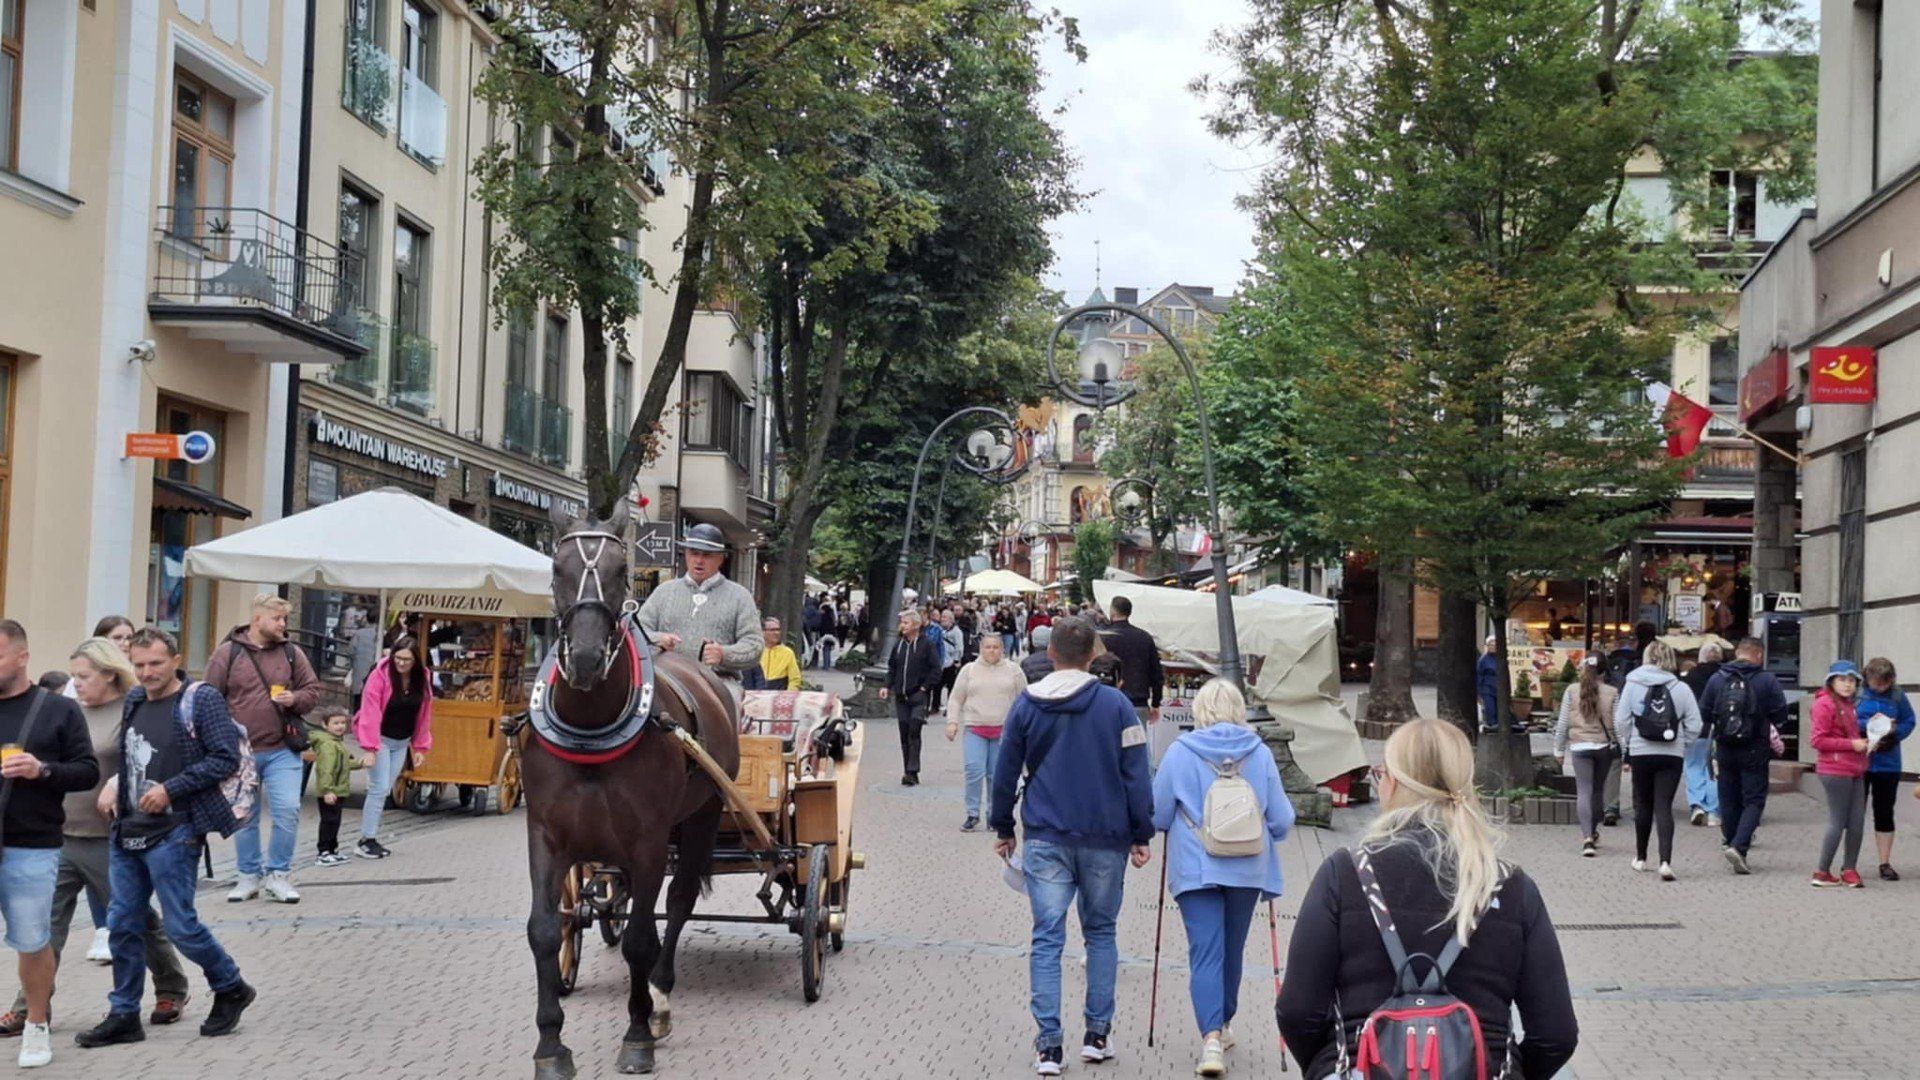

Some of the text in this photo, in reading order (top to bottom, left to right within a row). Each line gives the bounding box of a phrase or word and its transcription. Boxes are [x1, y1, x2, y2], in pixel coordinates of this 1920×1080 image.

[326, 422, 447, 478] MOUNTAIN WAREHOUSE
[502, 479, 540, 507] MOUNTAIN
[403, 593, 503, 612] OBWARZANKI
